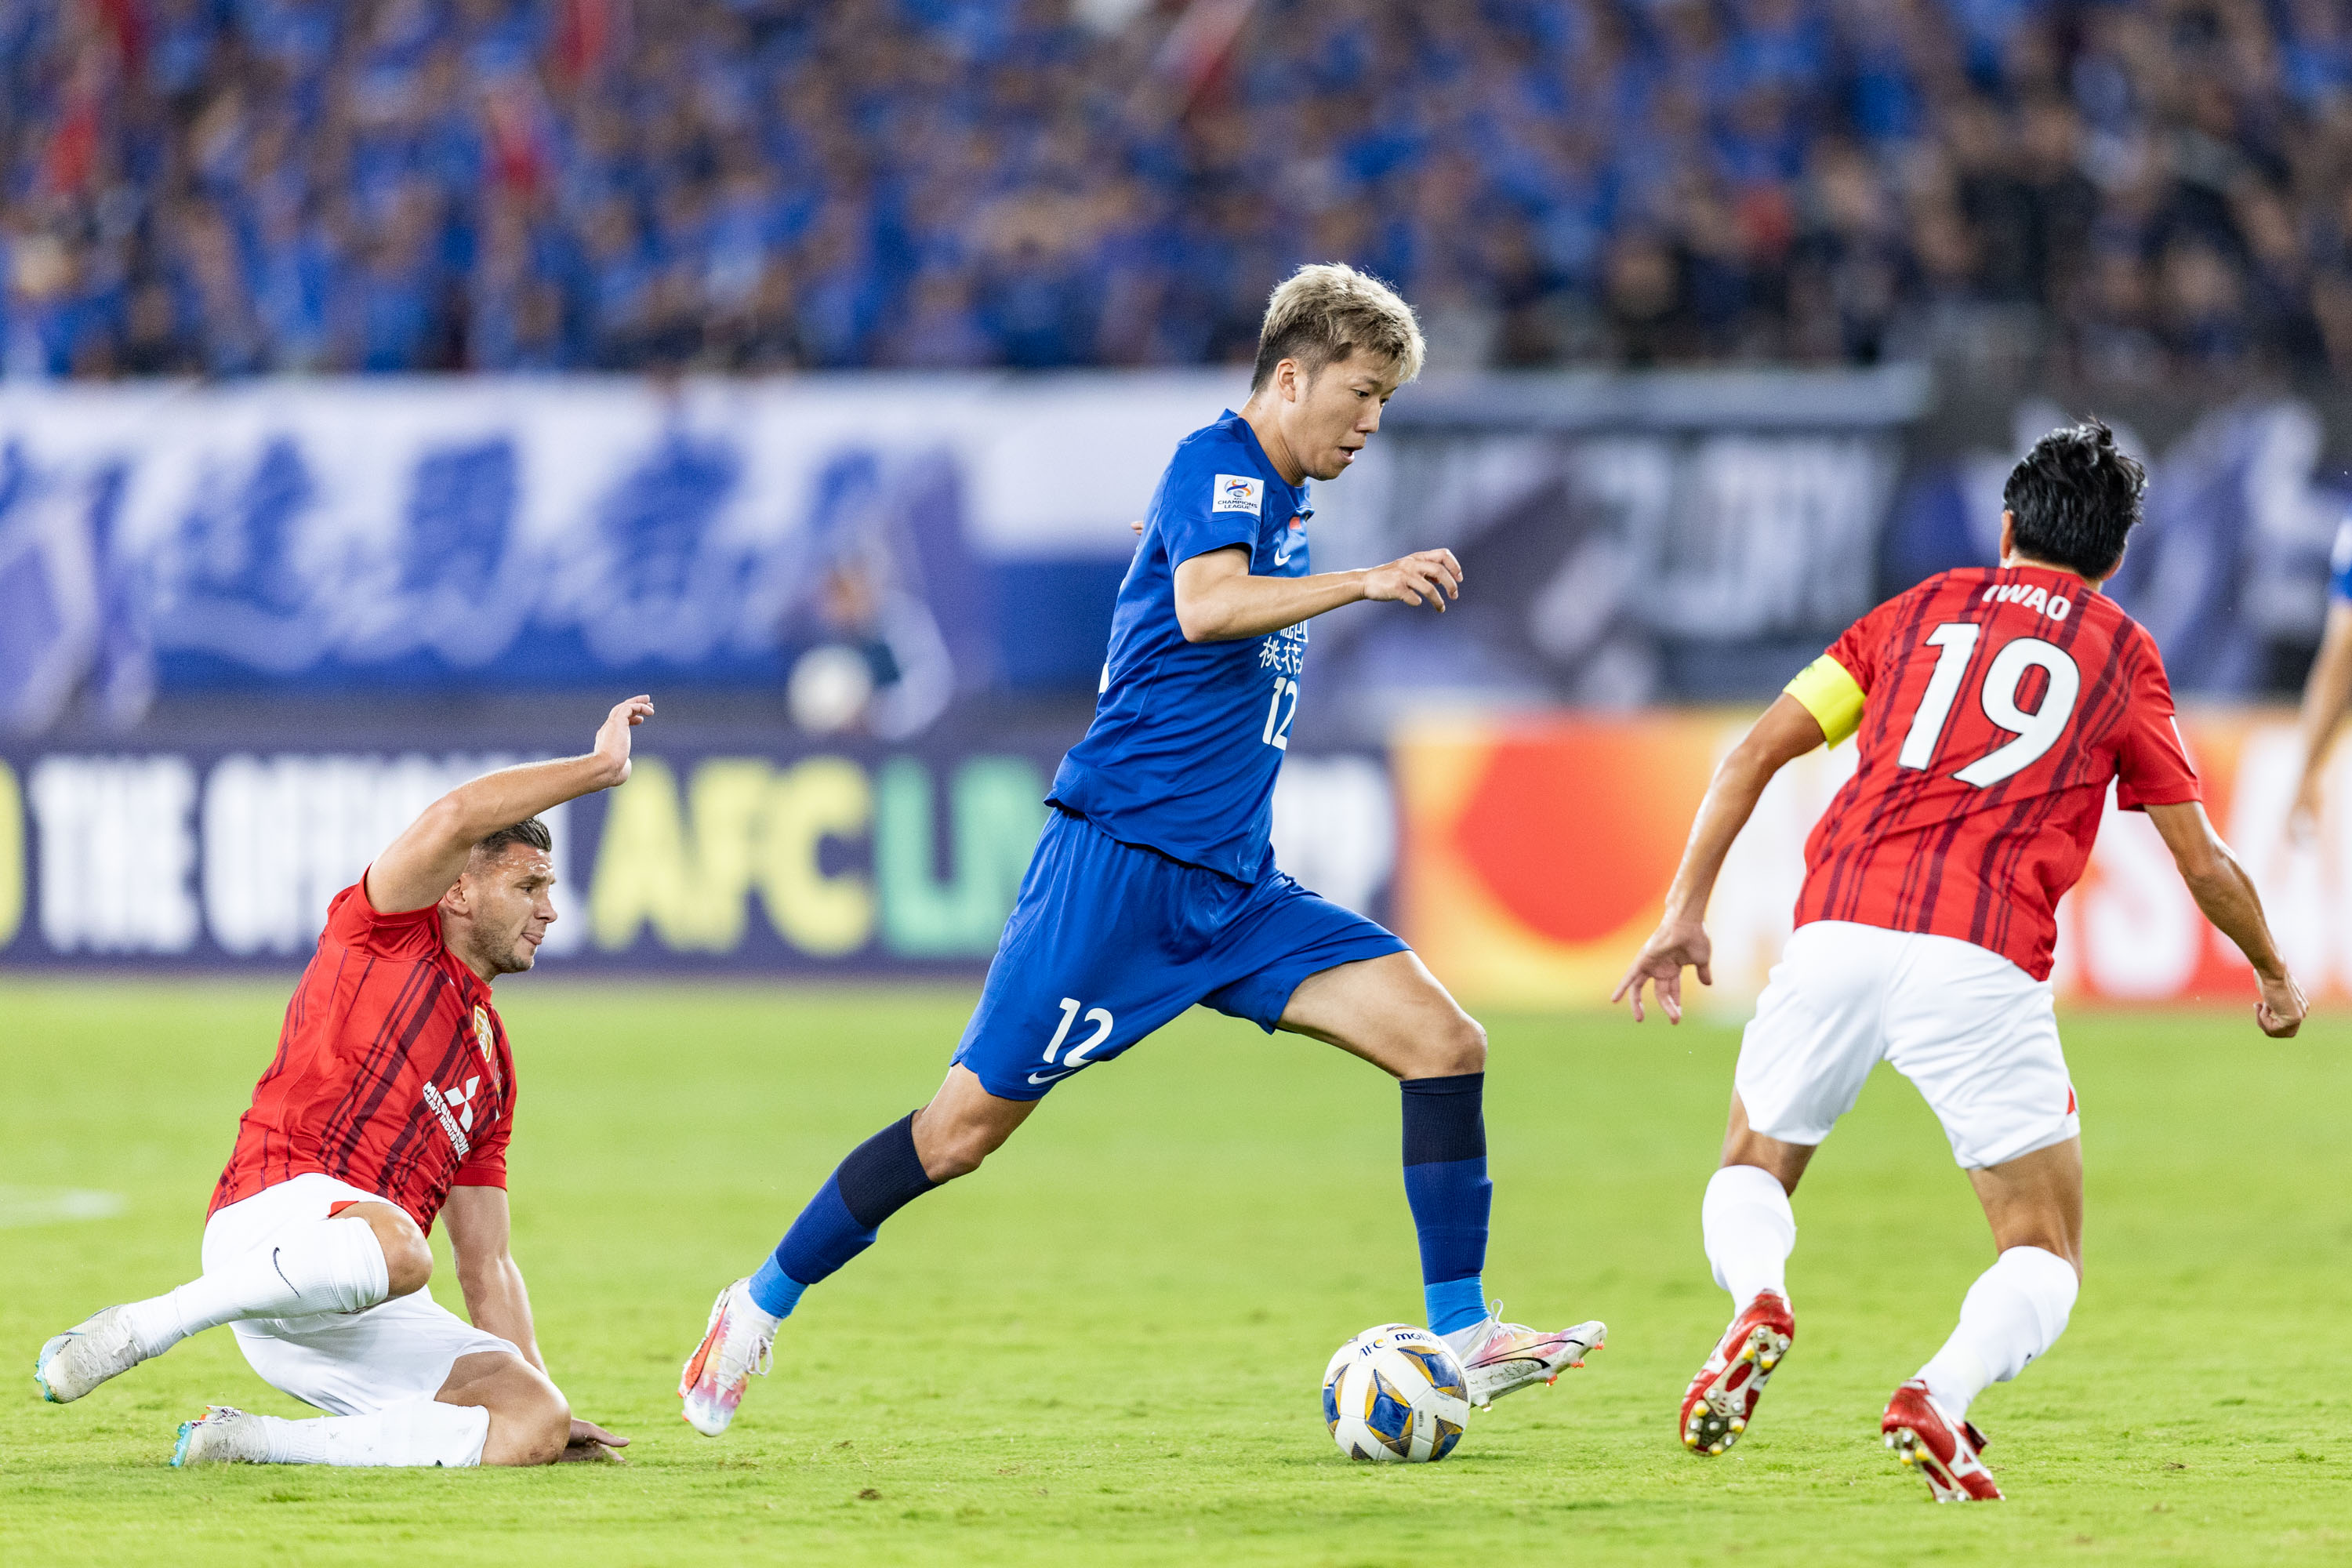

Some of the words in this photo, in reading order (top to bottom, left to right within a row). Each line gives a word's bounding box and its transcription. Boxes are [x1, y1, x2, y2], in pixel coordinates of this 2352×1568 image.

[1218, 499, 1258, 509] CHAMPIONS
[1981, 583, 2072, 622] IWAO
[1261, 677, 1298, 751] 12
[1897, 622, 2082, 789] 19
[590, 754, 872, 958] AFC
[1043, 997, 1113, 1068] 12
[423, 1080, 470, 1156] MITSUBISHI
[1359, 1338, 1386, 1362] AFC
